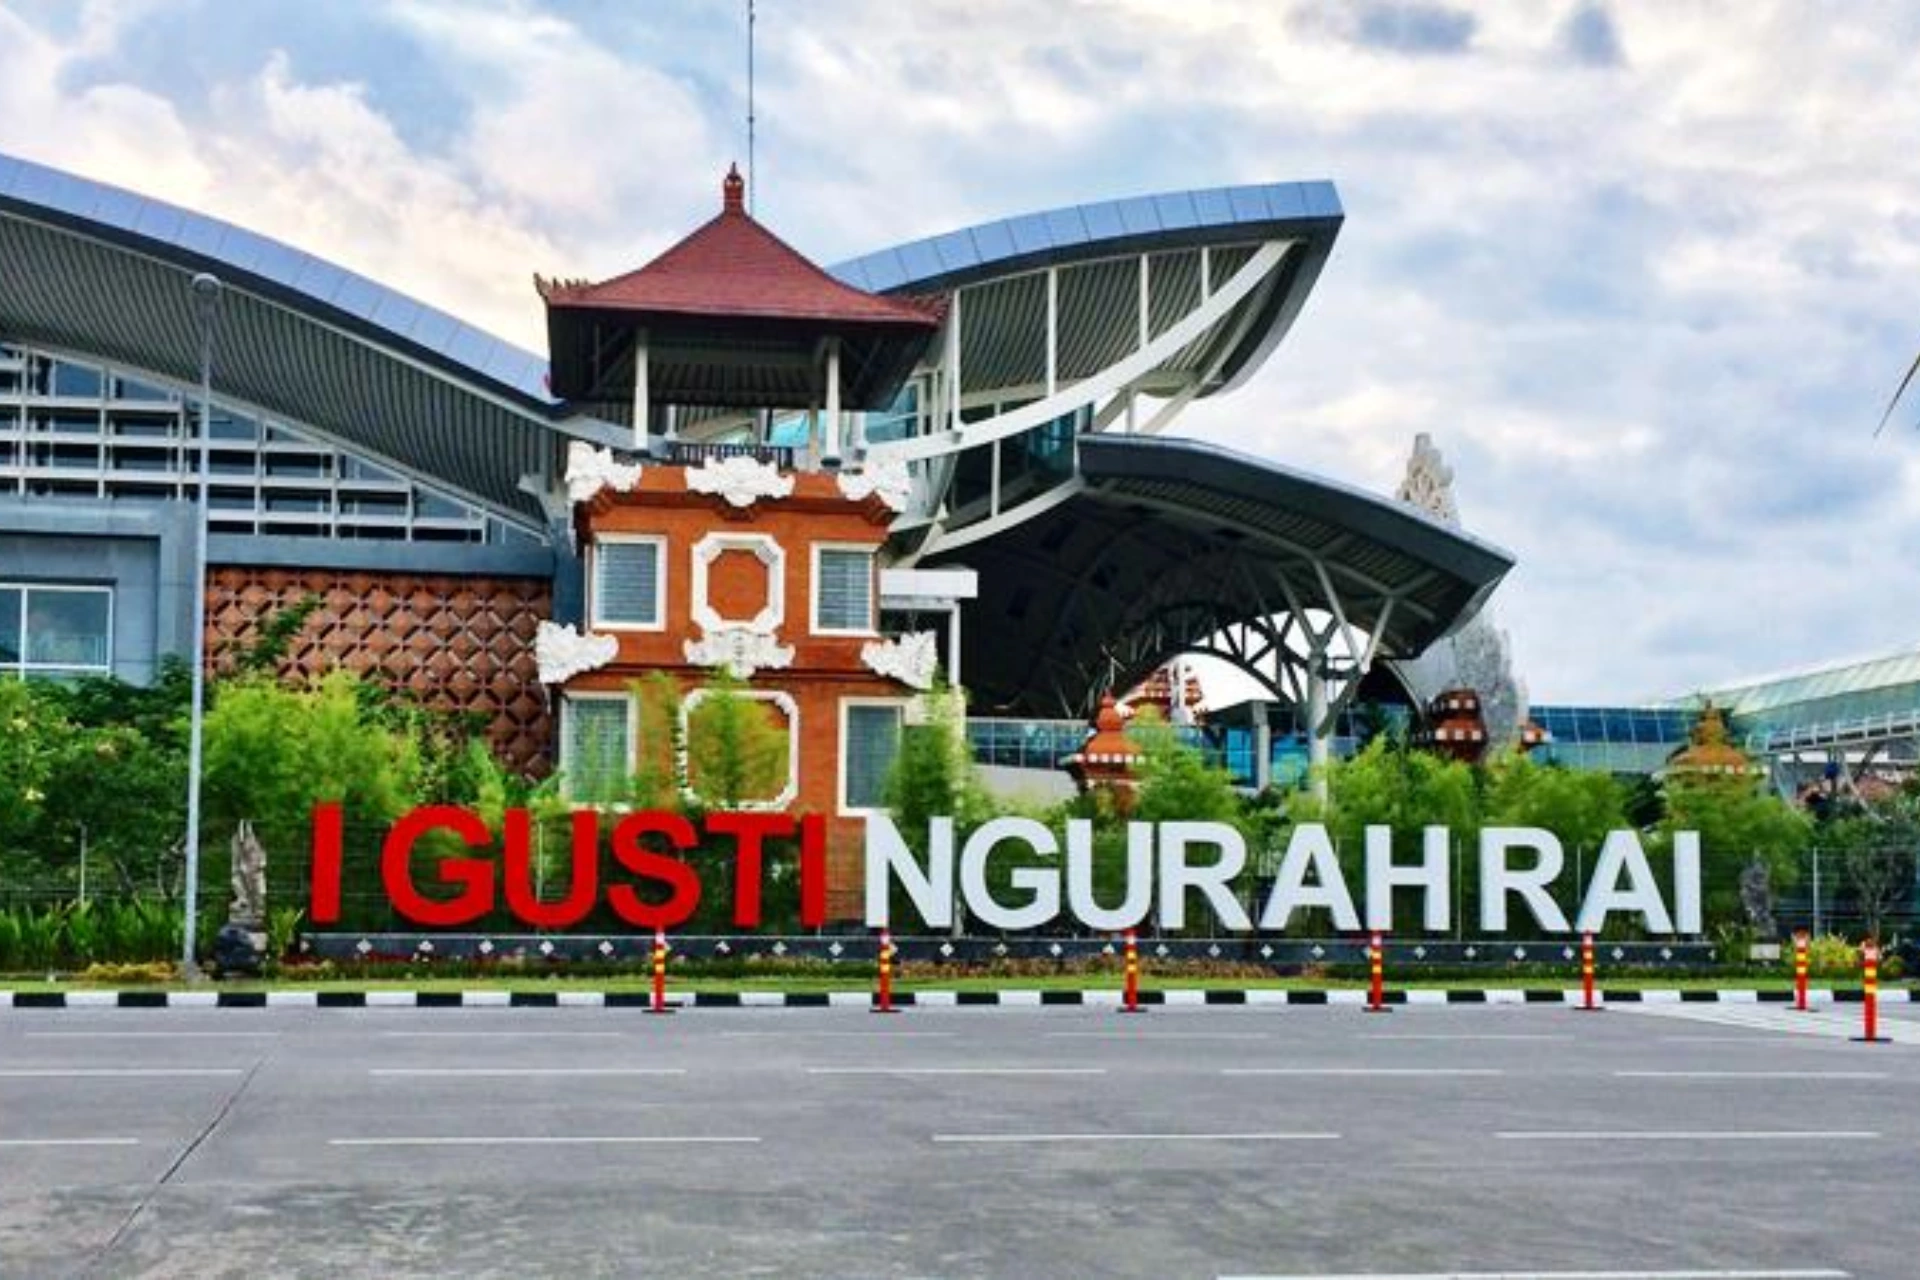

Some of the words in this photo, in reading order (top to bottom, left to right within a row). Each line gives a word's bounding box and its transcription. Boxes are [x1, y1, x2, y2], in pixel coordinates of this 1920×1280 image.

[310, 802, 342, 923] I
[381, 805, 827, 927] GUSTI
[864, 815, 1450, 931] NGURAH
[1479, 827, 1701, 934] RAI
